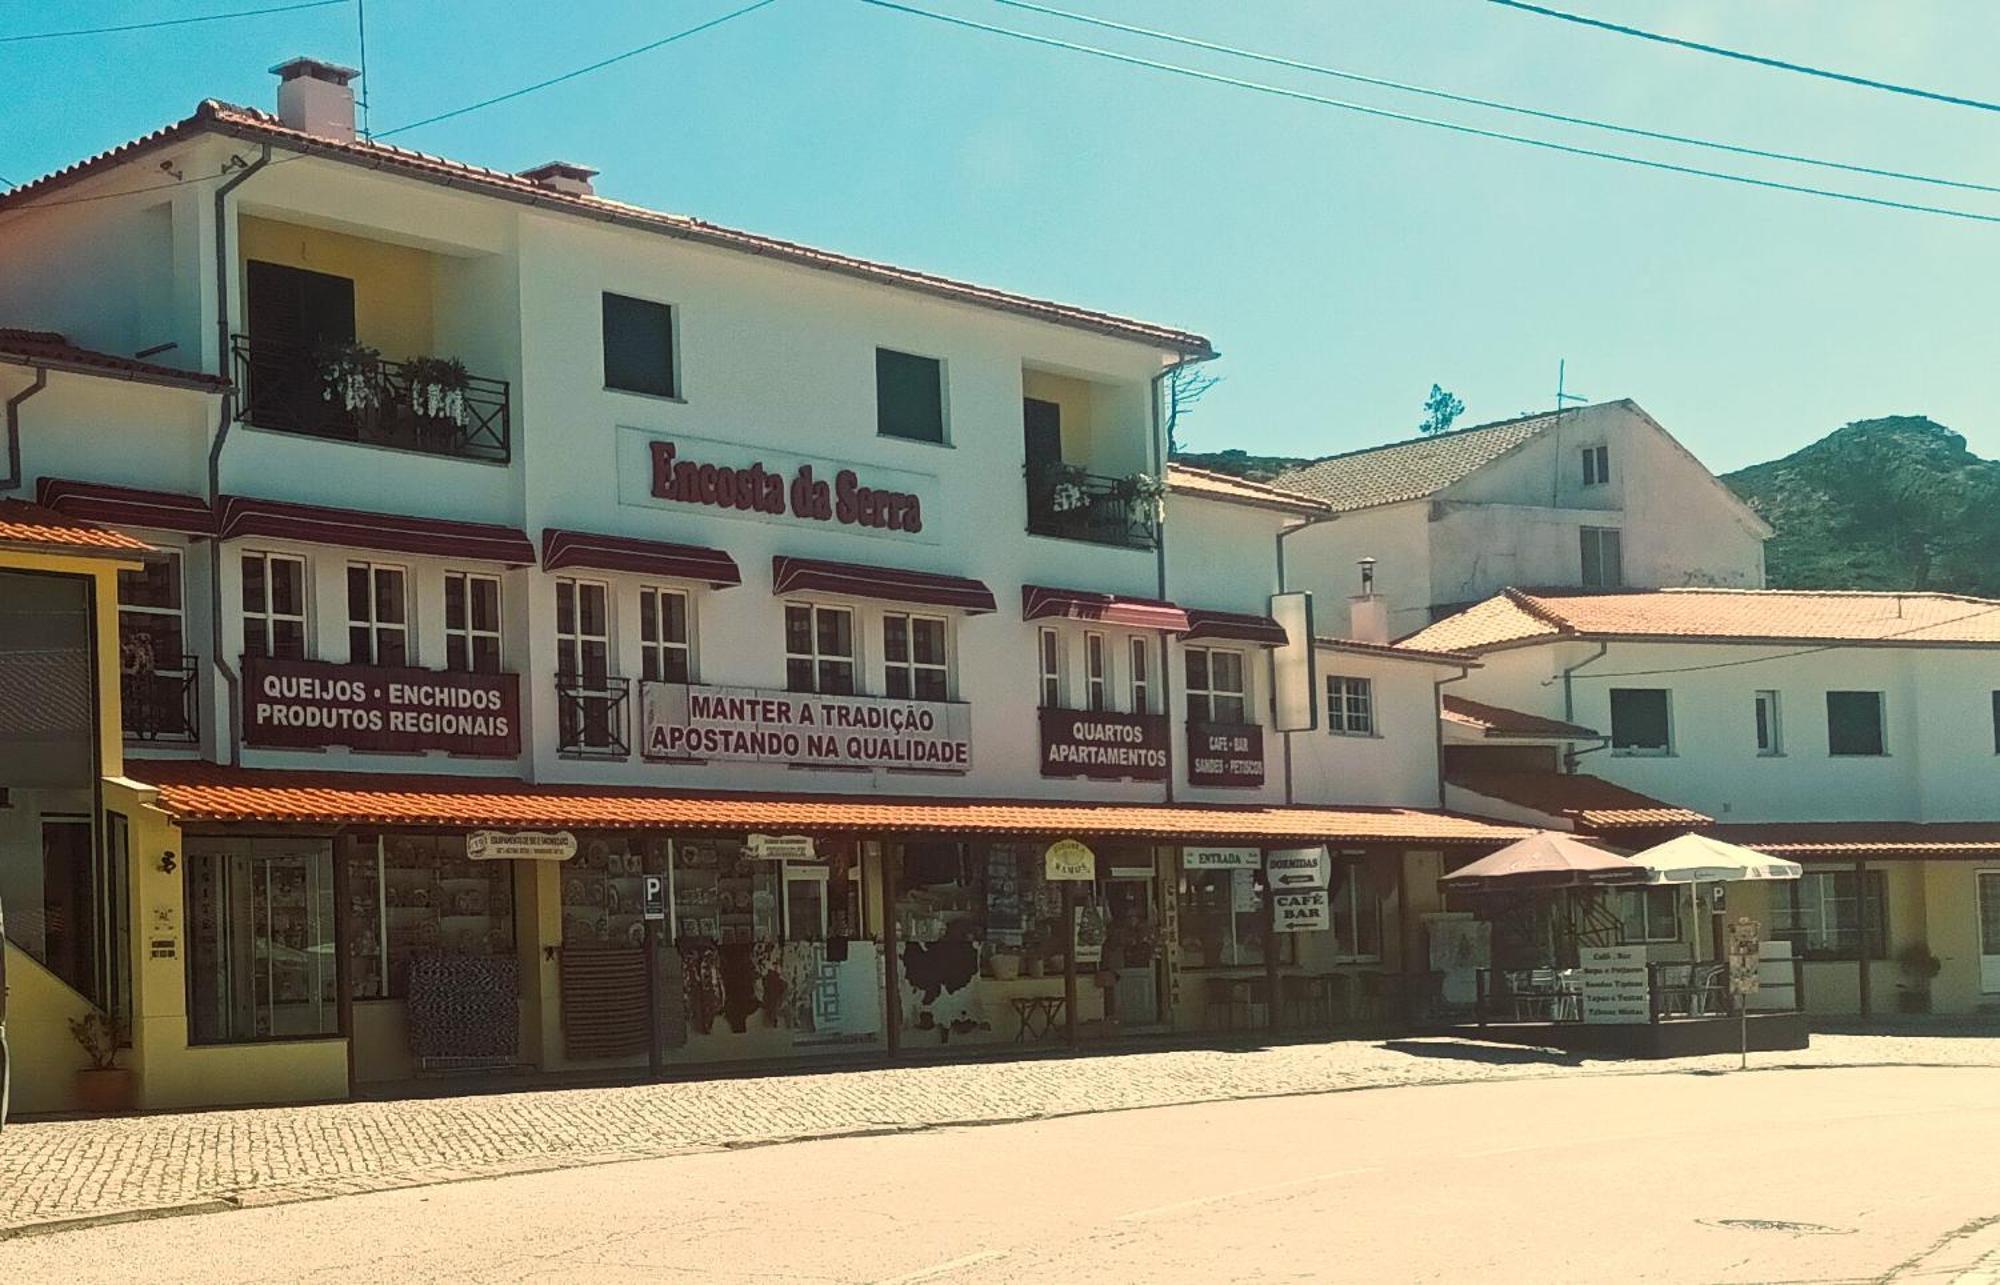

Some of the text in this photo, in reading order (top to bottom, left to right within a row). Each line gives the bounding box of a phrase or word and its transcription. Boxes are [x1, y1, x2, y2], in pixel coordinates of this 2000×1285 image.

[649, 440, 922, 533] Encosta da Serra
[263, 675, 502, 710] QUEIJOS ENCHIDOS
[256, 703, 509, 736] PRODUTOS REGIONAIS
[691, 695, 934, 735] MANTER A TRADIÇÃO
[1072, 722, 1143, 743] QUARTOS
[651, 725, 968, 764] APOSTANDO NA QUALIDADE
[1234, 737, 1248, 752] BAR
[1049, 744, 1166, 767] APARTAMENTOS
[1195, 758, 1263, 775] SANDES PETISCOS
[1199, 853, 1241, 865] ENTRADA
[1269, 858, 1318, 870] DORMIDAS
[647, 878, 660, 901] P
[1277, 893, 1324, 907] CAFÉ
[1714, 887, 1724, 902] P
[1284, 908, 1321, 919] BAR
